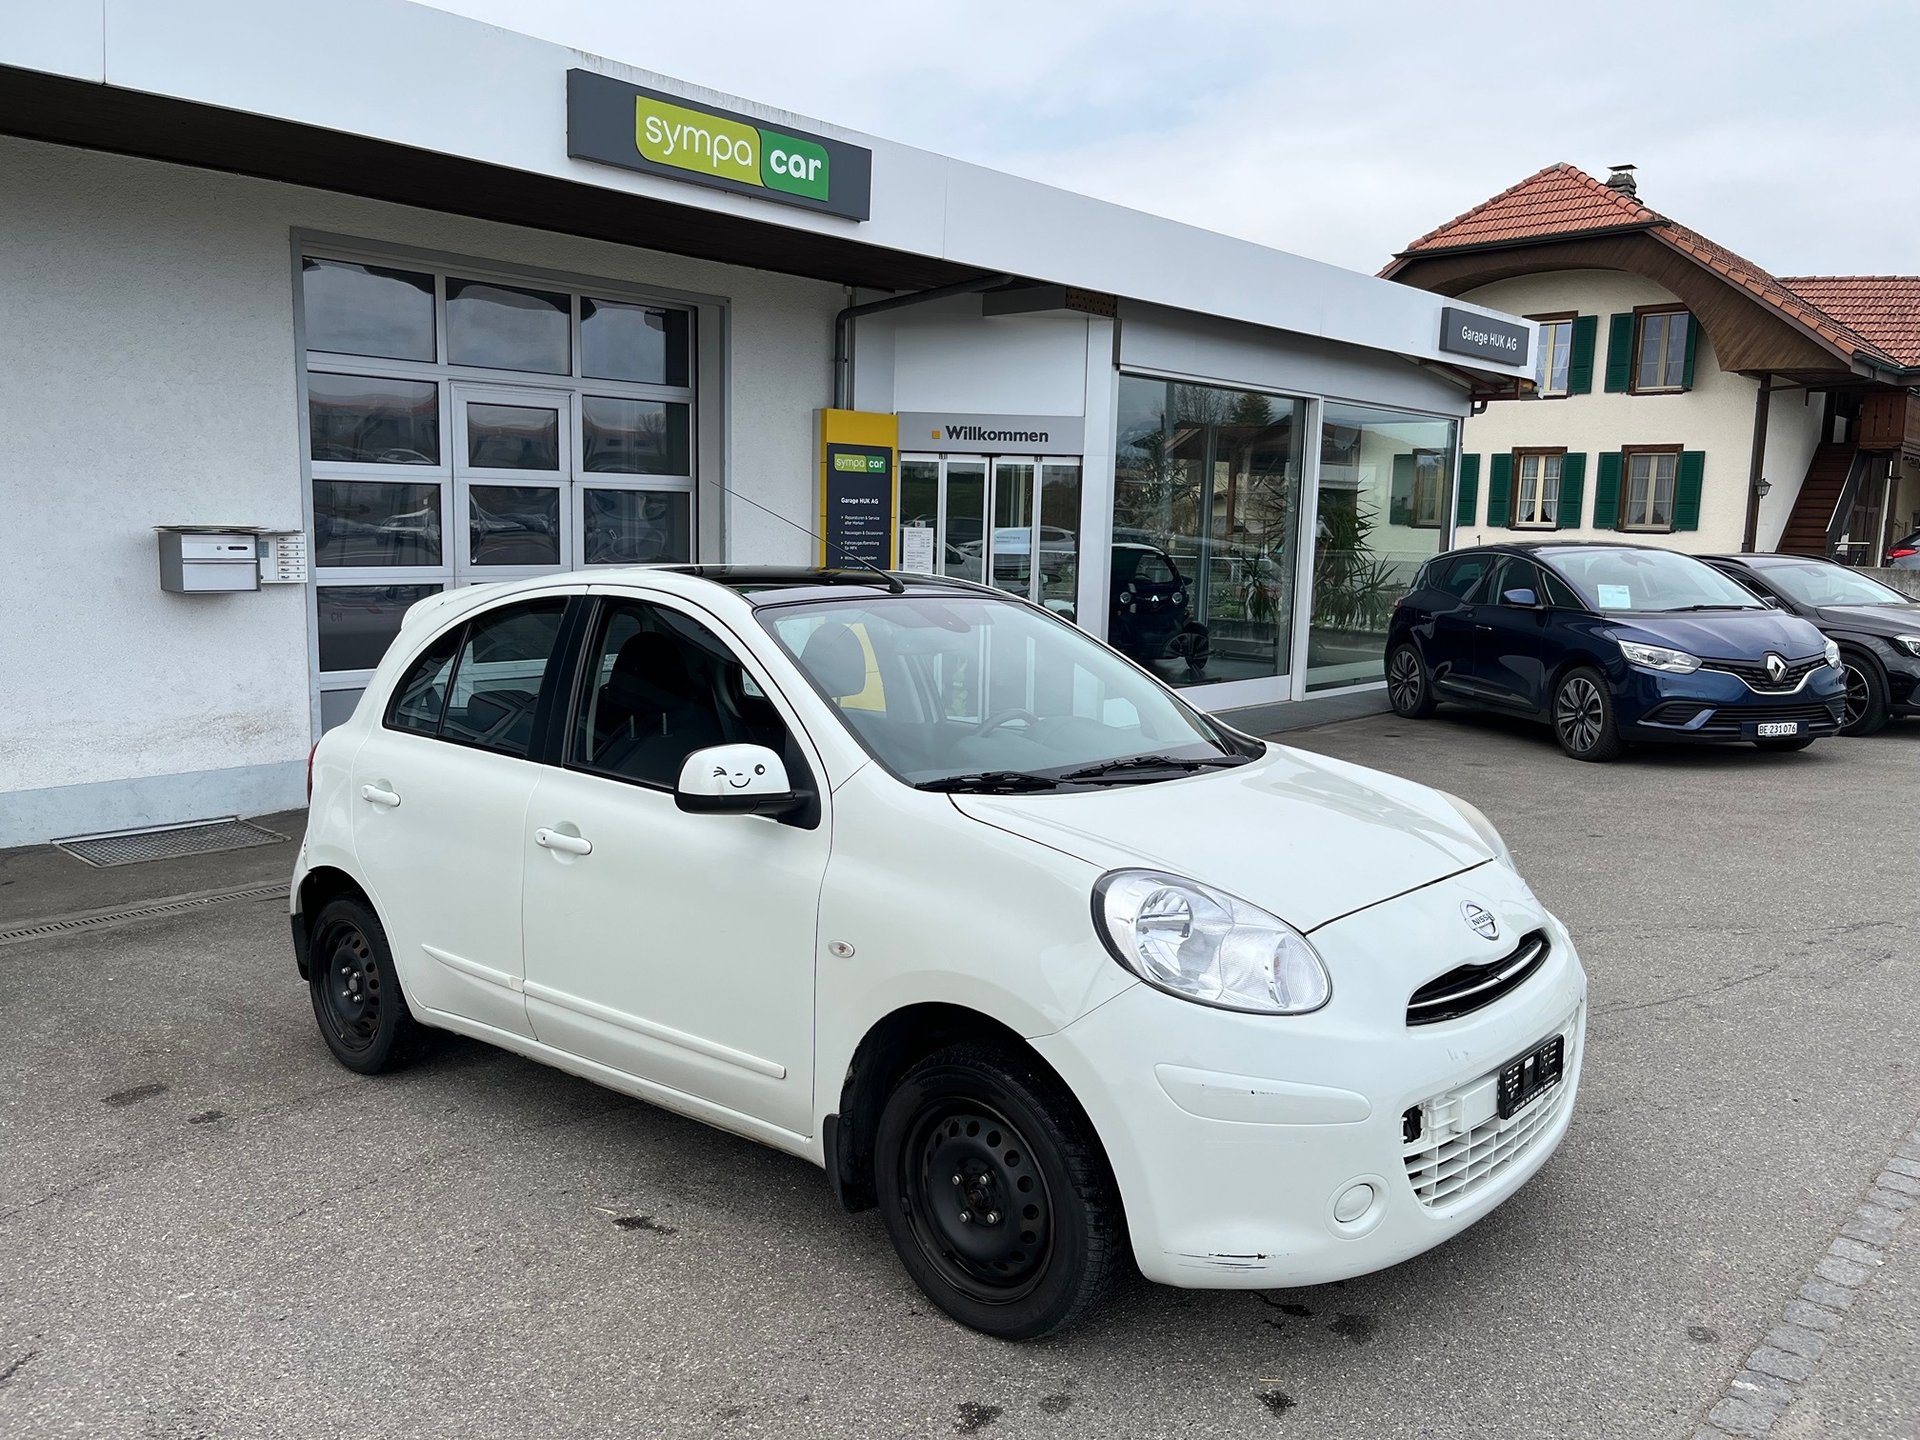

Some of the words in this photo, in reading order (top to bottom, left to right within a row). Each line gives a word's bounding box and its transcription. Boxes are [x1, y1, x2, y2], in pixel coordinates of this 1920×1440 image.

[645, 115, 752, 168] sympa
[769, 149, 822, 182] car
[1461, 325, 1488, 345] Garage
[1489, 332, 1505, 349] HUK
[1505, 336, 1517, 351] AG
[945, 425, 1049, 442] Willkommen
[836, 458, 865, 470] sympa
[868, 460, 884, 469] car
[840, 497, 859, 505] Garage
[1769, 724, 1796, 734] 231076
